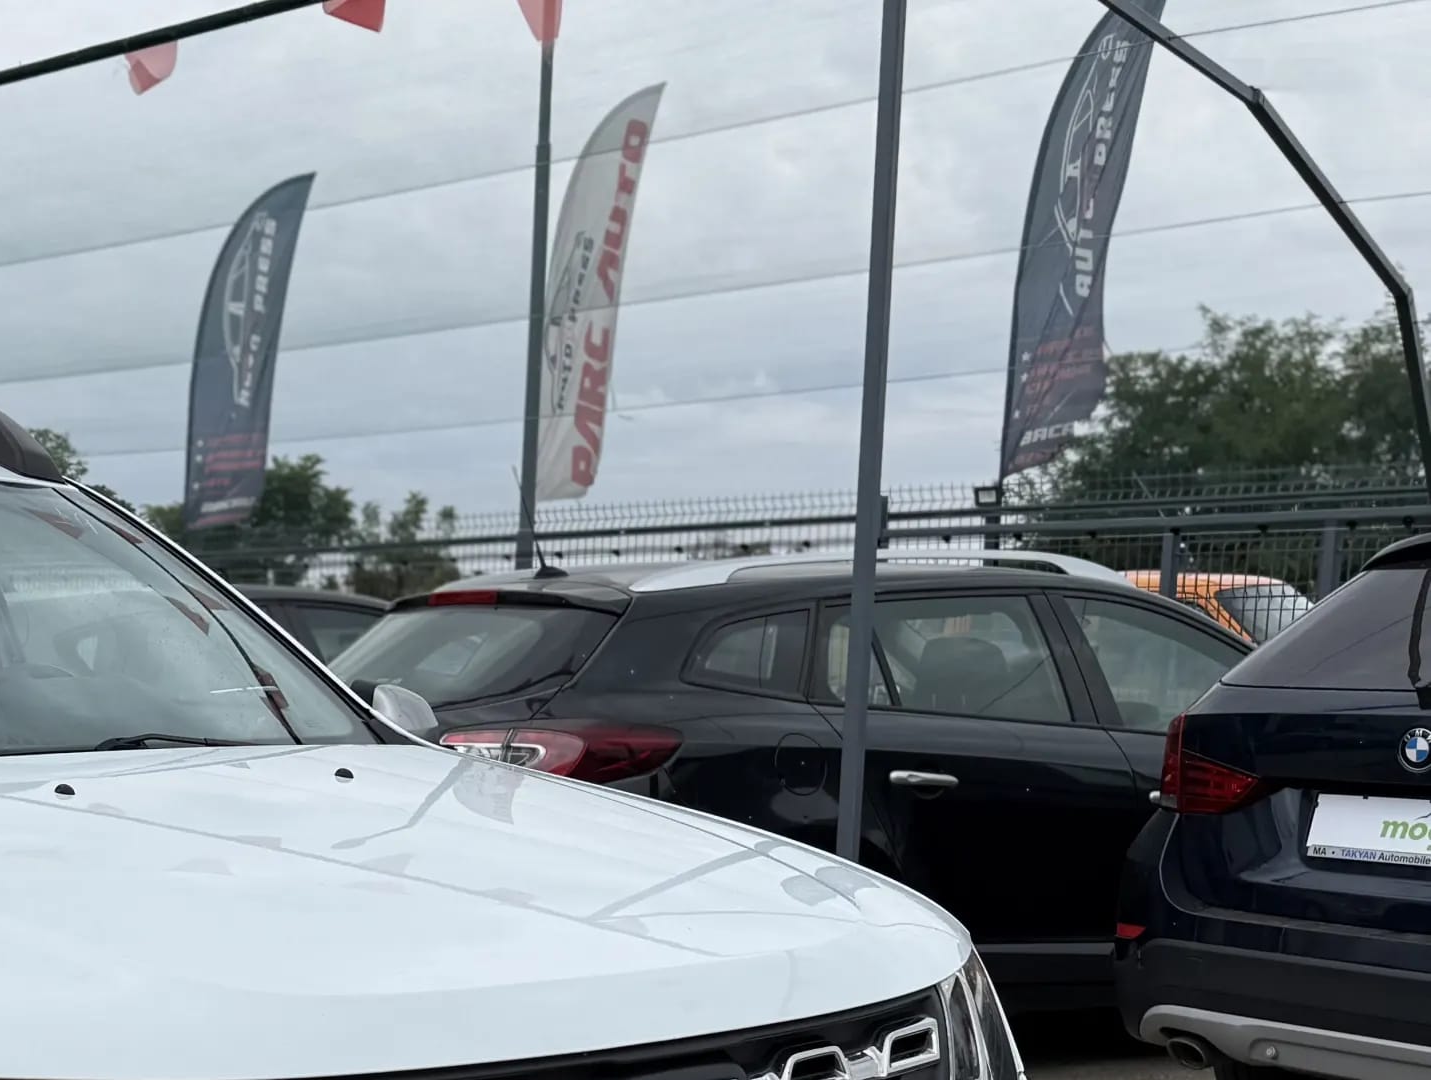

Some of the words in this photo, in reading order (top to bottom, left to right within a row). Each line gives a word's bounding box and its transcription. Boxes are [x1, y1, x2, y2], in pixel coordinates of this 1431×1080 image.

[571, 321, 611, 488] PARC
[596, 118, 649, 306] AUTO
[1312, 846, 1327, 856] MA
[1340, 849, 1377, 861] TAKYAN
